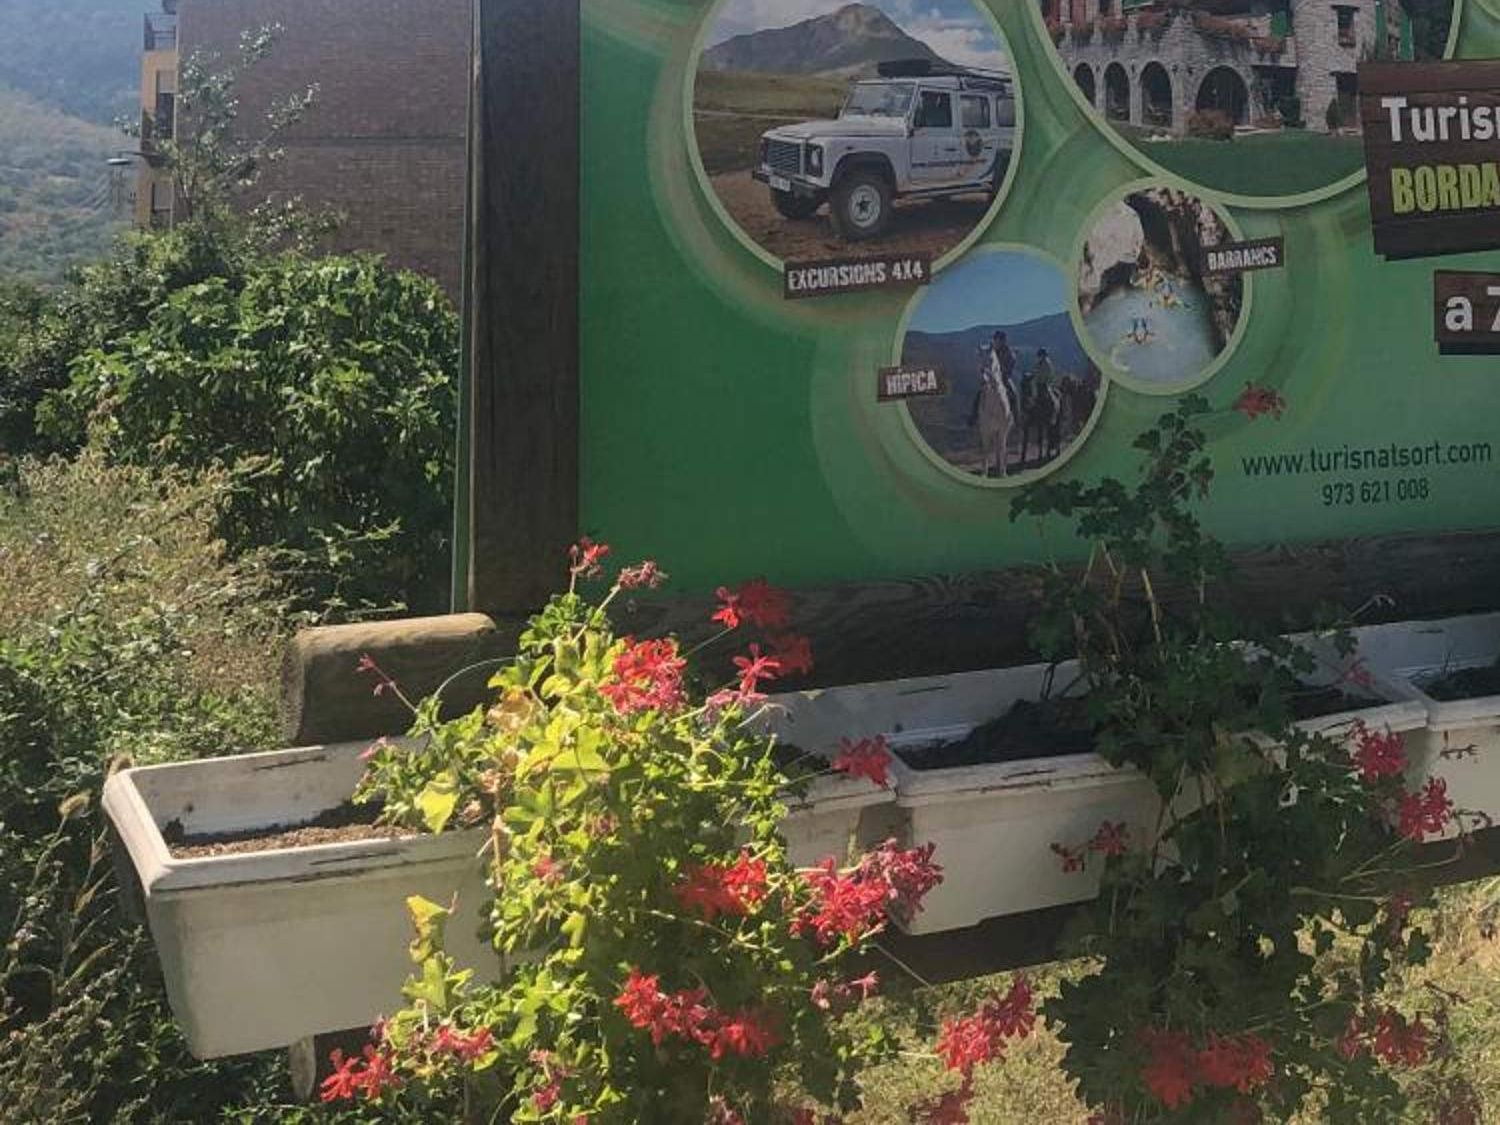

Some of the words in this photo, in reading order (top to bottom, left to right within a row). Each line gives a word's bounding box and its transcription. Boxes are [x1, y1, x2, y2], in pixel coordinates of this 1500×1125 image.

[788, 262, 886, 290] EXCURSIONS
[892, 259, 923, 280] 4X4
[1445, 295, 1473, 332] a
[1241, 440, 1492, 476] www.turisnatsort.com
[1322, 481, 1355, 506] 973
[1361, 480, 1389, 504] 621
[1397, 477, 1429, 501] 008
